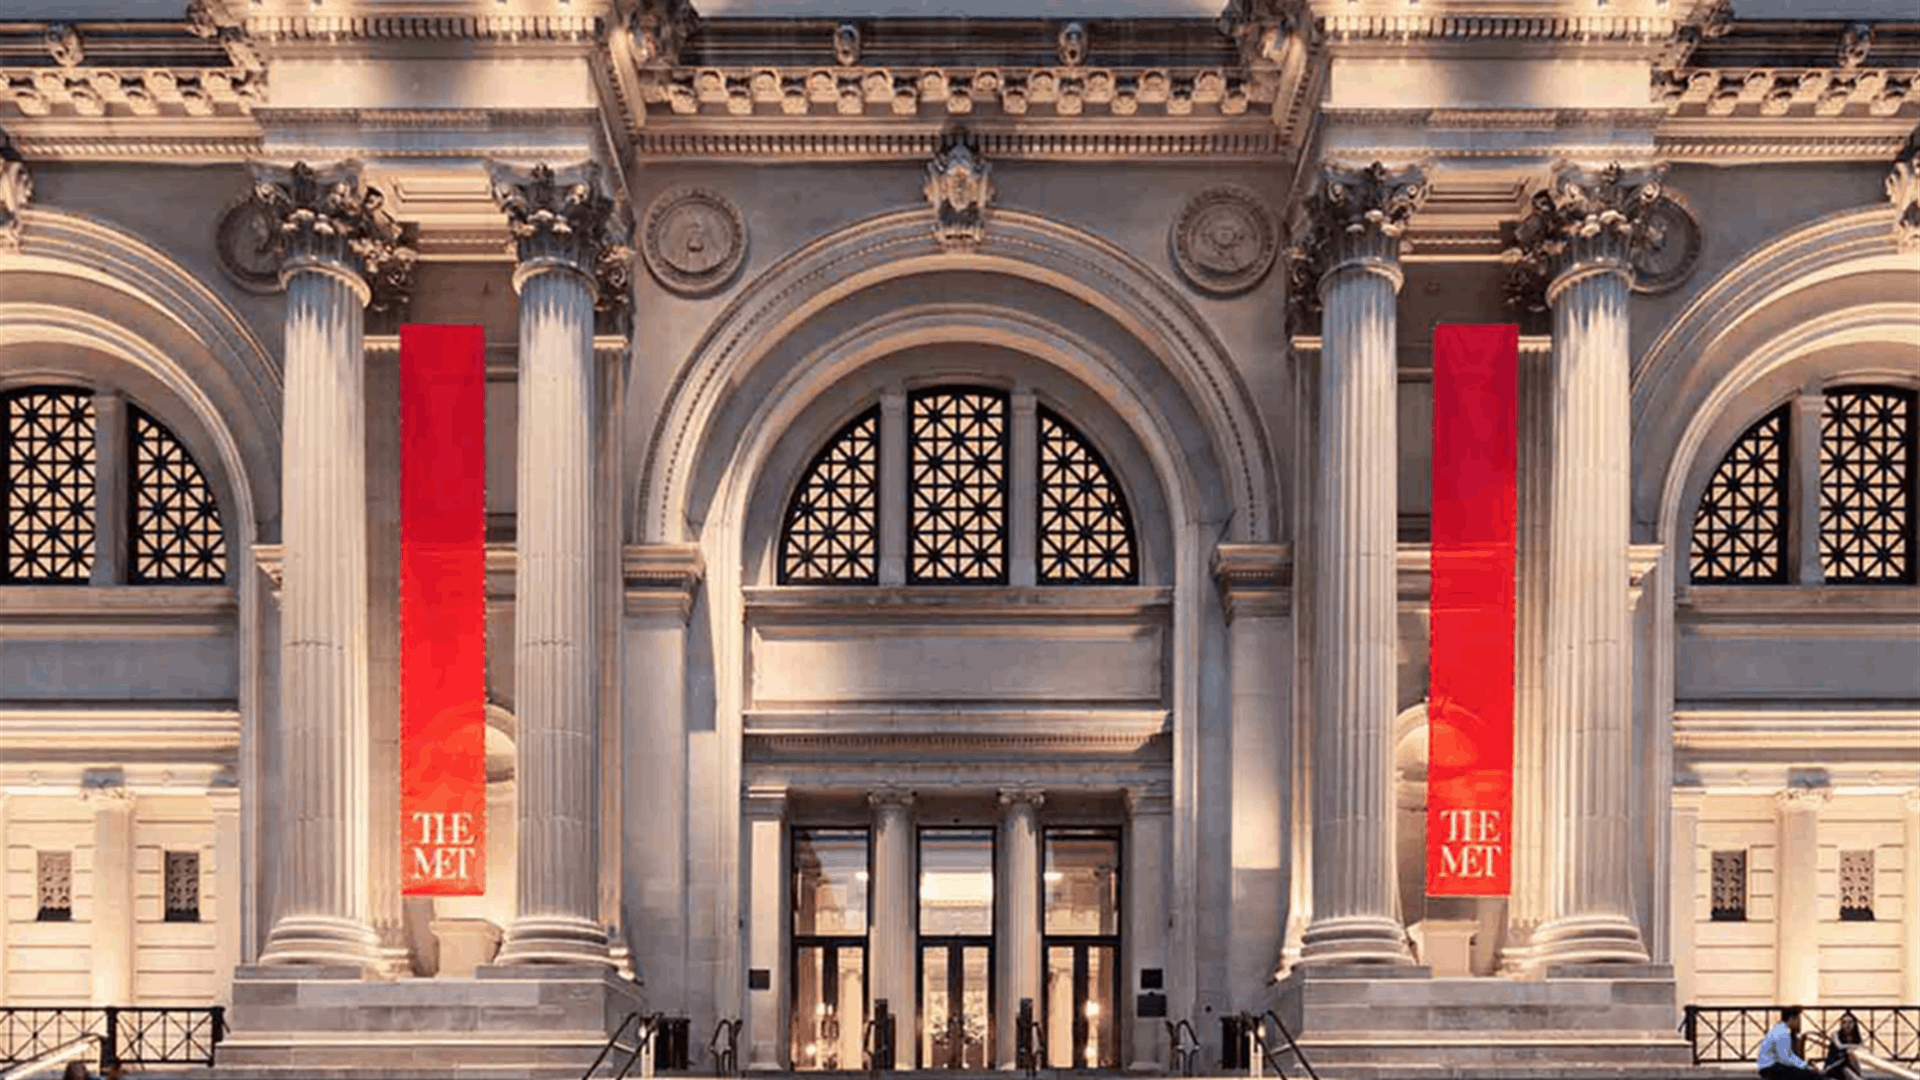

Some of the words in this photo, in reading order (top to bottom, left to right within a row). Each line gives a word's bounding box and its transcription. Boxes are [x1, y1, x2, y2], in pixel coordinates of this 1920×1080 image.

[412, 812, 474, 844] THE
[1440, 809, 1501, 842] THE
[412, 847, 475, 879] MET
[1439, 845, 1502, 877] MET
